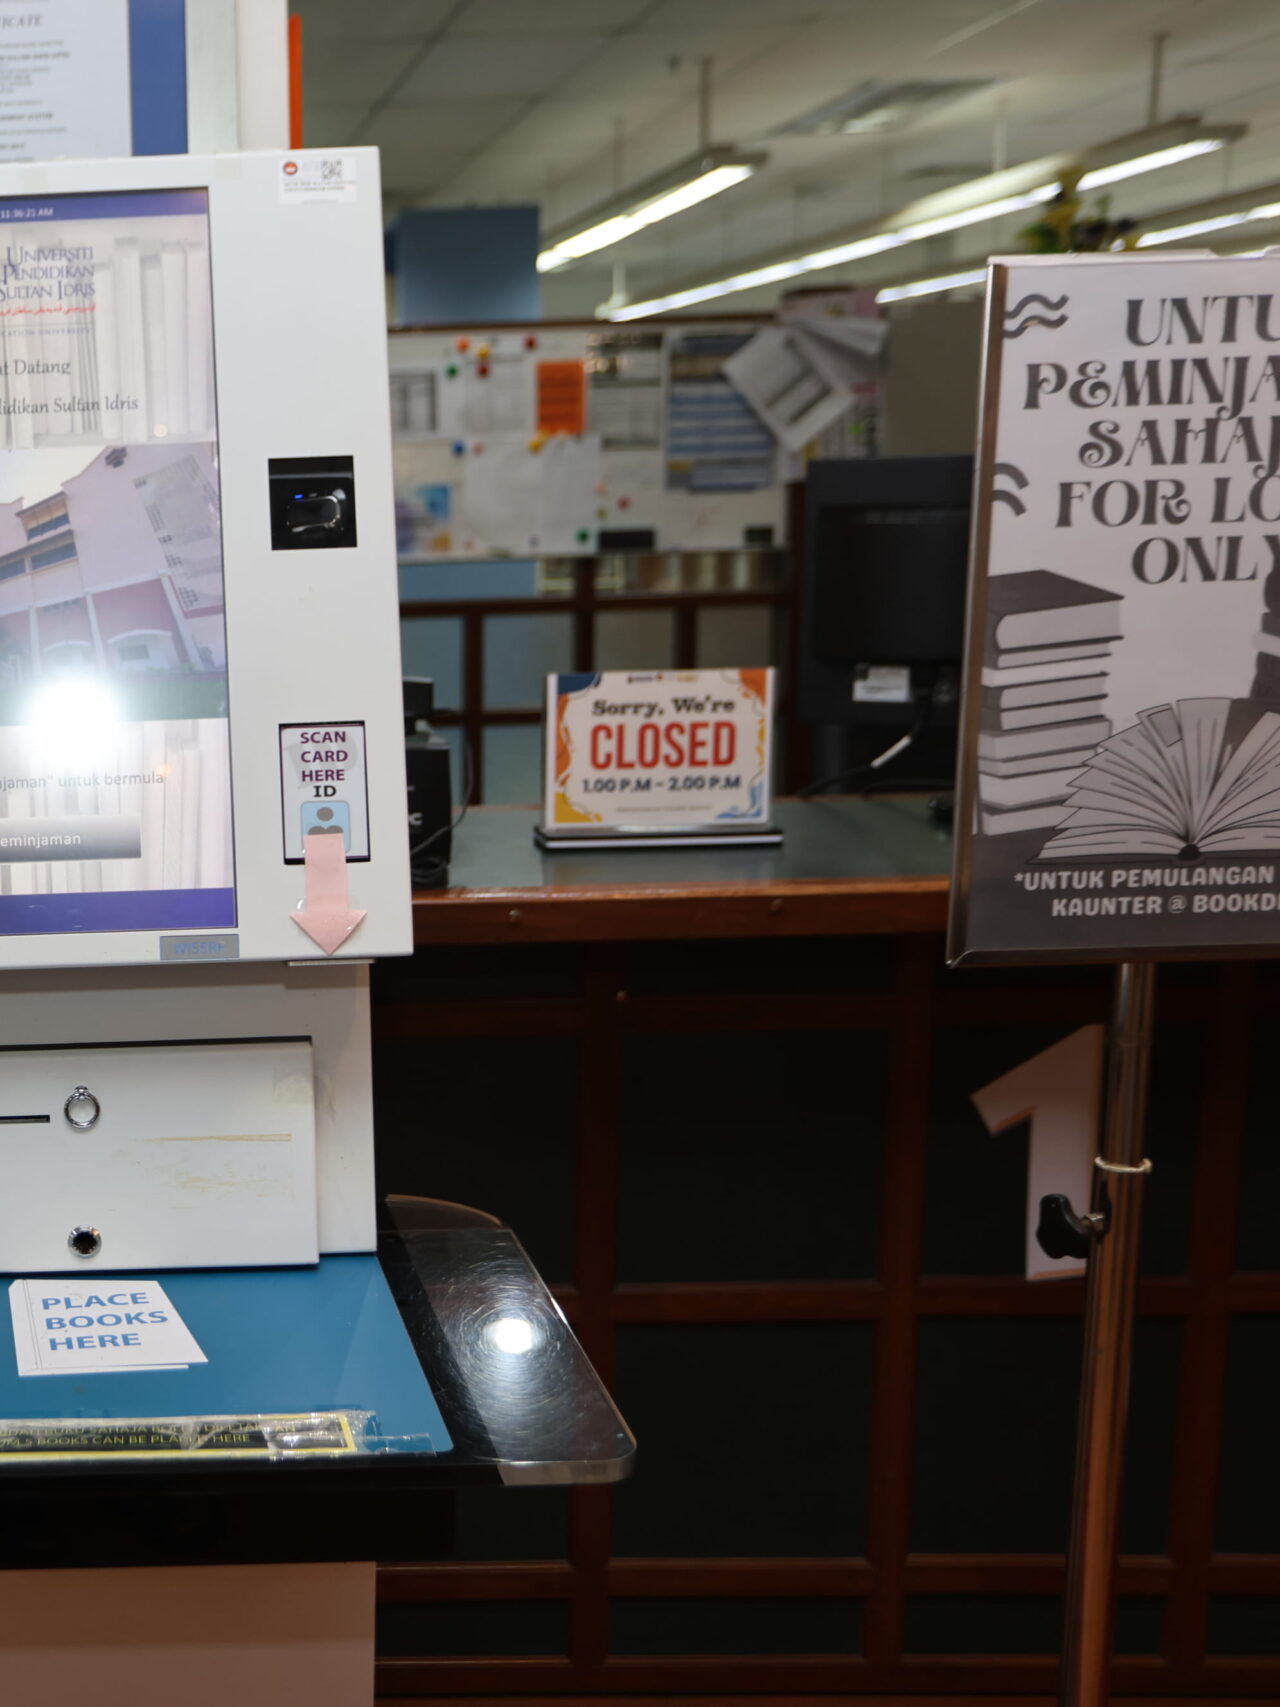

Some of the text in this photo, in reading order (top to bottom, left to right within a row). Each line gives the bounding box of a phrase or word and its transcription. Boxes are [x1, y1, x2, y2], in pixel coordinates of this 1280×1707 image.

[38, 207, 53, 217] AM
[14, 360, 71, 376] Datang
[54, 396, 100, 413] Sultan
[105, 395, 139, 411] Idris
[1055, 478, 1191, 528] FOR
[592, 695, 736, 718] Sorry, We're
[300, 731, 347, 744] SCAN
[590, 721, 737, 770] CLOSED
[300, 750, 348, 763] CARD
[58, 774, 99, 788] untuk
[105, 771, 164, 786] bermula
[301, 769, 346, 782] HERE
[582, 779, 616, 793] 1.00
[620, 777, 651, 792] P.M
[668, 776, 705, 791] 2.00
[709, 775, 741, 790] P.M
[313, 785, 337, 797] ID
[1111, 865, 1274, 889] PEMULANGAN
[1051, 893, 1280, 917] KAUNTER @ BOOKD
[971, 1023, 1105, 1281] 1
[42, 1292, 149, 1310] PLACE
[45, 1311, 168, 1330] BOOKS
[49, 1333, 142, 1350] HERE
[37, 1436, 88, 1446] BOOKS
[92, 1434, 124, 1445] CAN
[129, 1434, 146, 1444] BE
[212, 1433, 251, 1444] HERE
